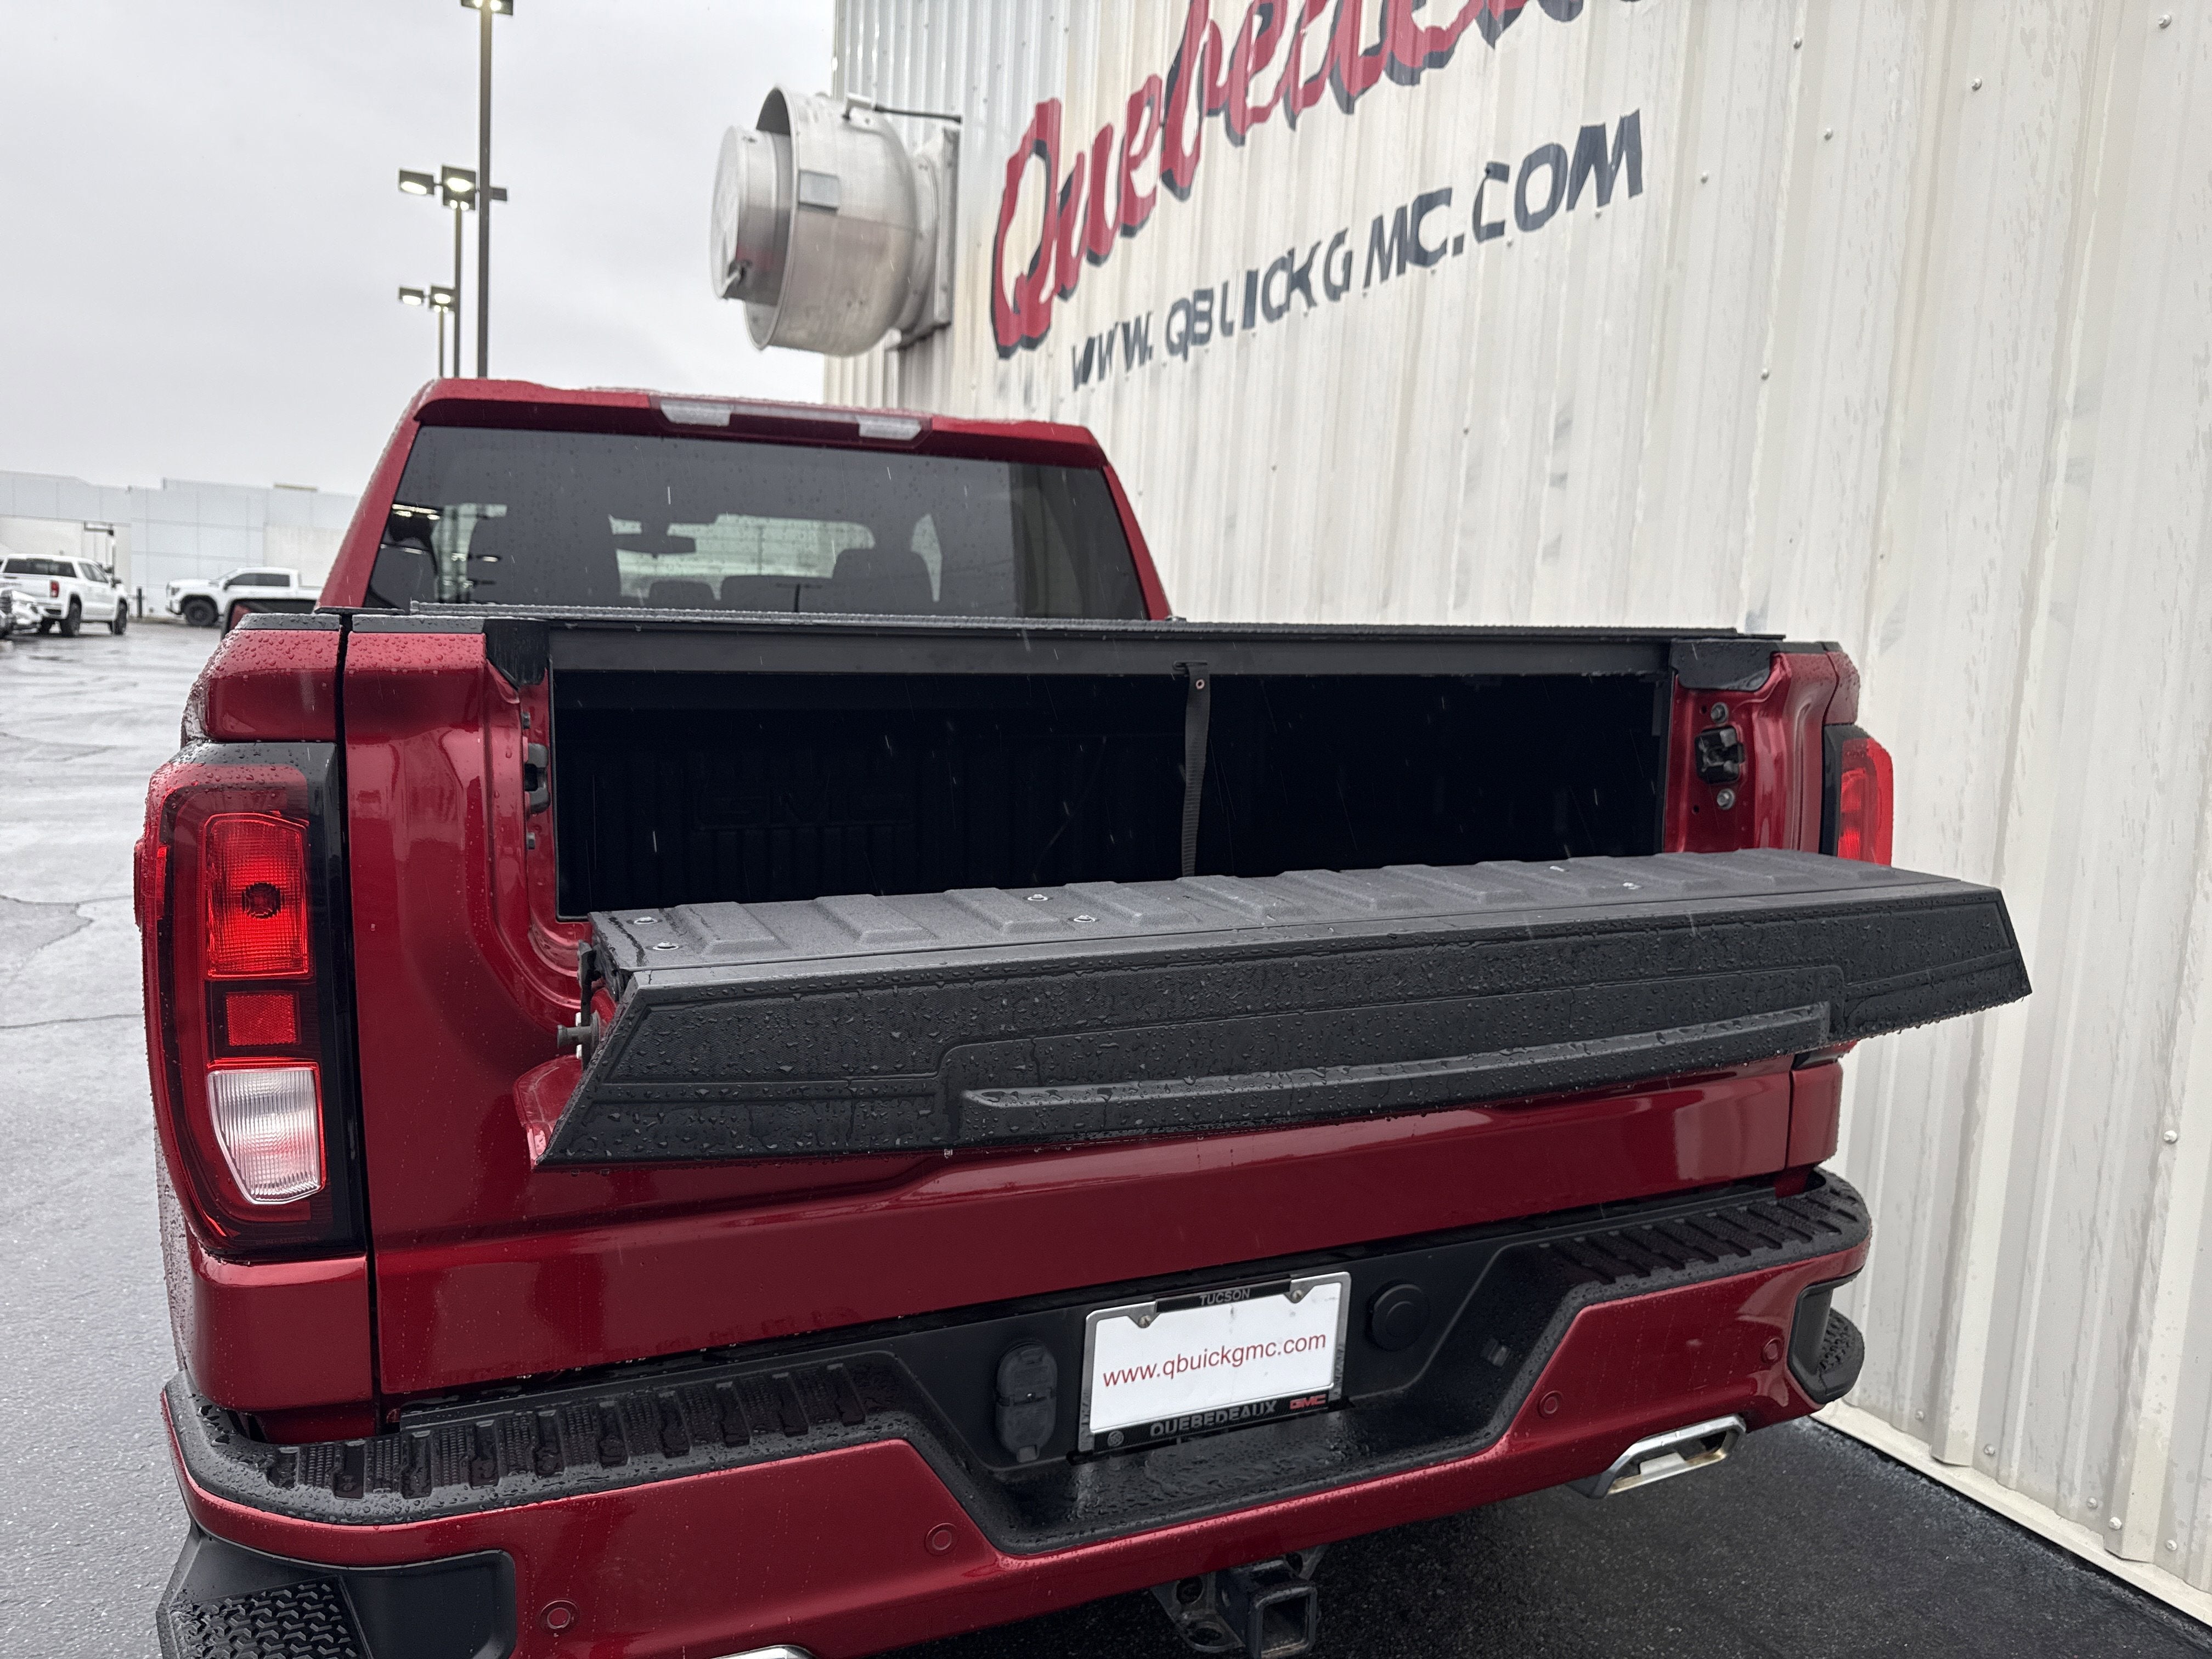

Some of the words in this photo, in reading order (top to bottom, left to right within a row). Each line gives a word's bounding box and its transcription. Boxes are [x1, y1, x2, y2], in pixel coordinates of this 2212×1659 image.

[990, 0, 1647, 359] Quebed
[1199, 1288, 1251, 1306] TUCSON
[1103, 1333, 1327, 1387] www.qbuickgmc.com
[1150, 1401, 1278, 1437] QUEBEDEAUX
[1289, 1393, 1327, 1410] GMC
